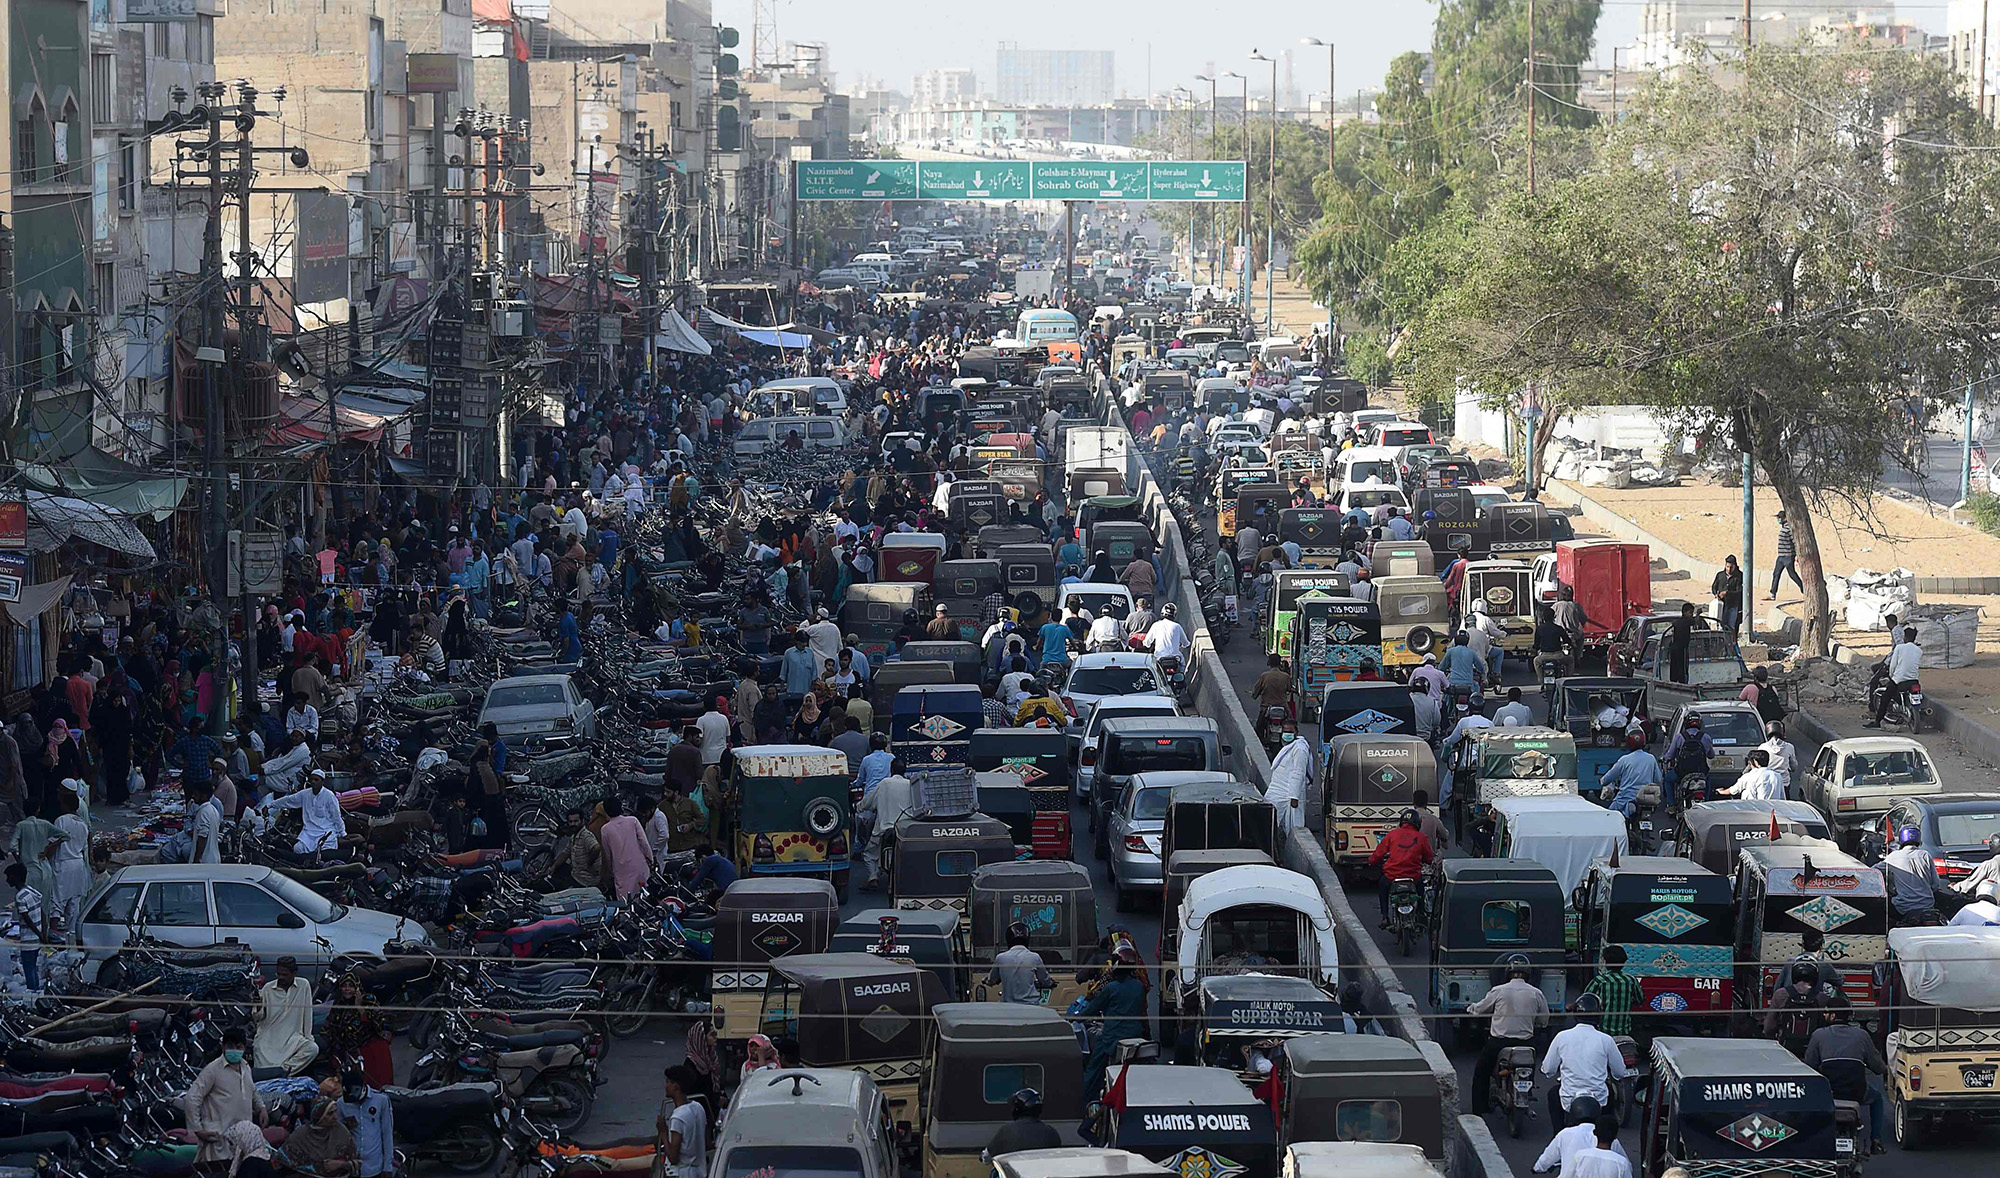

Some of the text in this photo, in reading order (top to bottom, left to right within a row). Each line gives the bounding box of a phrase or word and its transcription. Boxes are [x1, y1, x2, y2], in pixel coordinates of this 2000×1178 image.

[806, 166, 854, 175] Nazimabad
[923, 169, 943, 181] Naya
[1038, 168, 1107, 179] Gulshan-E-Maymar
[1153, 168, 1187, 178] Hyderabad
[805, 177, 835, 185] S.I.T.E
[923, 180, 965, 189] Nazimabad
[1037, 180, 1099, 190] Sohrab Goth
[1153, 181, 1200, 191] Super Highway
[806, 187, 826, 195] Civic
[829, 187, 856, 195] Center
[1290, 578, 1339, 587] SHAMS POWER
[1343, 605, 1369, 614] POWER
[1366, 749, 1409, 758] SAZGAR
[932, 828, 980, 837] SAZGAR
[1734, 831, 1768, 840] SAZG
[1013, 894, 1063, 904] SAZGAR
[1650, 894, 1694, 903] ROplant.pk
[751, 913, 804, 923] SAZGAR
[1021, 911, 1039, 926] OVE
[1029, 919, 1043, 933] IFE
[1694, 978, 1721, 990] GAR
[854, 982, 911, 997] SAZGAR
[1250, 1001, 1271, 1010] MALIK
[1231, 1009, 1323, 1026] SUPER STAR
[1703, 1083, 1753, 1101] SHAMS
[1143, 1114, 1251, 1131] SHAMS POWER
